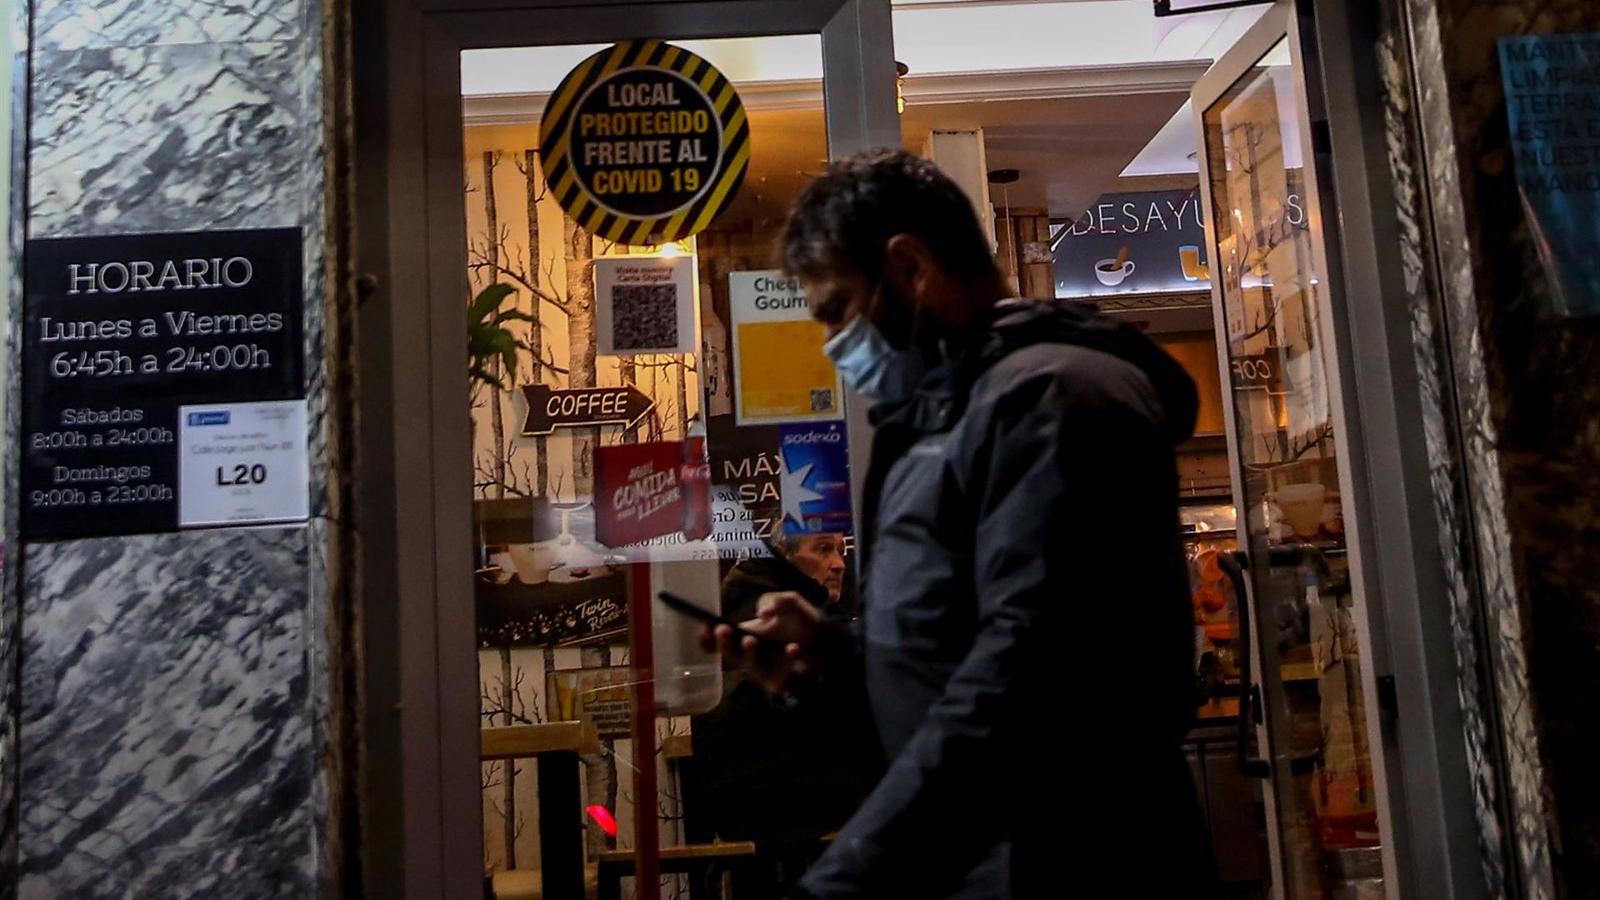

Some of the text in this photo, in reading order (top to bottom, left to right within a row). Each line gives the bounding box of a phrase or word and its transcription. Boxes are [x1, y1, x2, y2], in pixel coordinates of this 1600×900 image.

[608, 82, 680, 107] LOCAL
[581, 110, 709, 137] PROTEGIDO
[584, 139, 708, 166] FRENTE AL
[1521, 145, 1600, 168] NUEST
[592, 168, 699, 194] COVID 19
[1525, 172, 1600, 195] MANO
[67, 256, 253, 295] HORARIO
[754, 277, 805, 294] Cheq
[40, 311, 284, 342] Lunes a Viernes
[51, 344, 272, 378] 6:45h a 24:00h
[546, 392, 628, 417] COFFEE
[32, 427, 174, 448] 8:00h a 24:00h
[784, 428, 841, 445] sodexo
[55, 465, 151, 482] Domingos
[217, 463, 267, 486] L20
[32, 484, 174, 506] 9:00h a 23:00h
[613, 466, 677, 512] COMIDA
[739, 482, 780, 504] SA
[753, 518, 772, 539] Z
